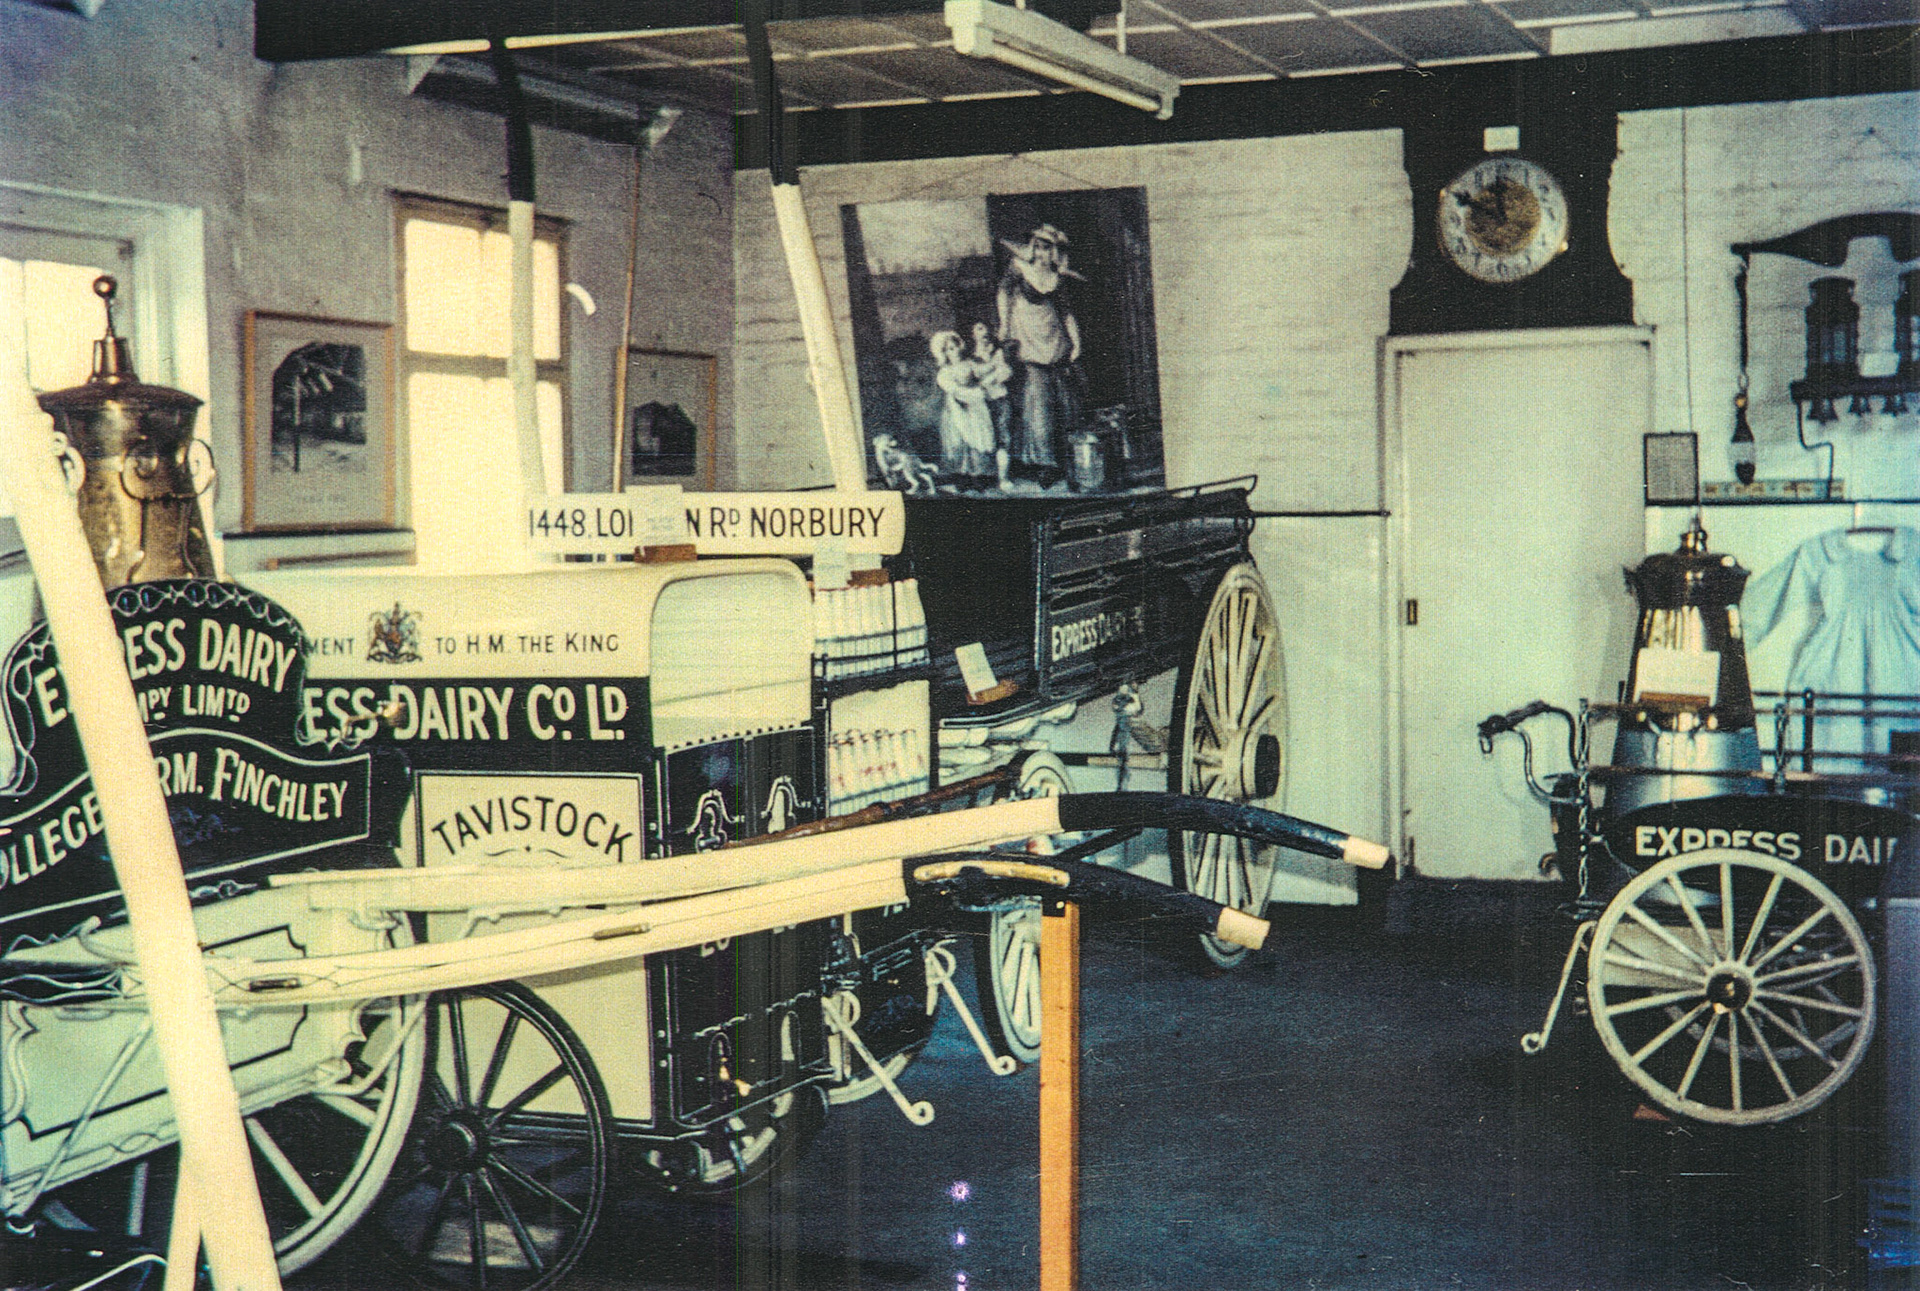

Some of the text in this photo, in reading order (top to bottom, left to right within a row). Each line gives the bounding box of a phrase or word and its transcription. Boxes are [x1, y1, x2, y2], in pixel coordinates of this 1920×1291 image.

[750, 506, 885, 538] NORBURY
[200, 618, 297, 693] DAIRY
[435, 637, 456, 655] TO
[518, 634, 554, 652] THE
[565, 631, 620, 652] KING
[389, 683, 514, 741] DAIRY
[211, 747, 348, 823] FINCHLEY
[430, 795, 633, 863] TAVISTOCK
